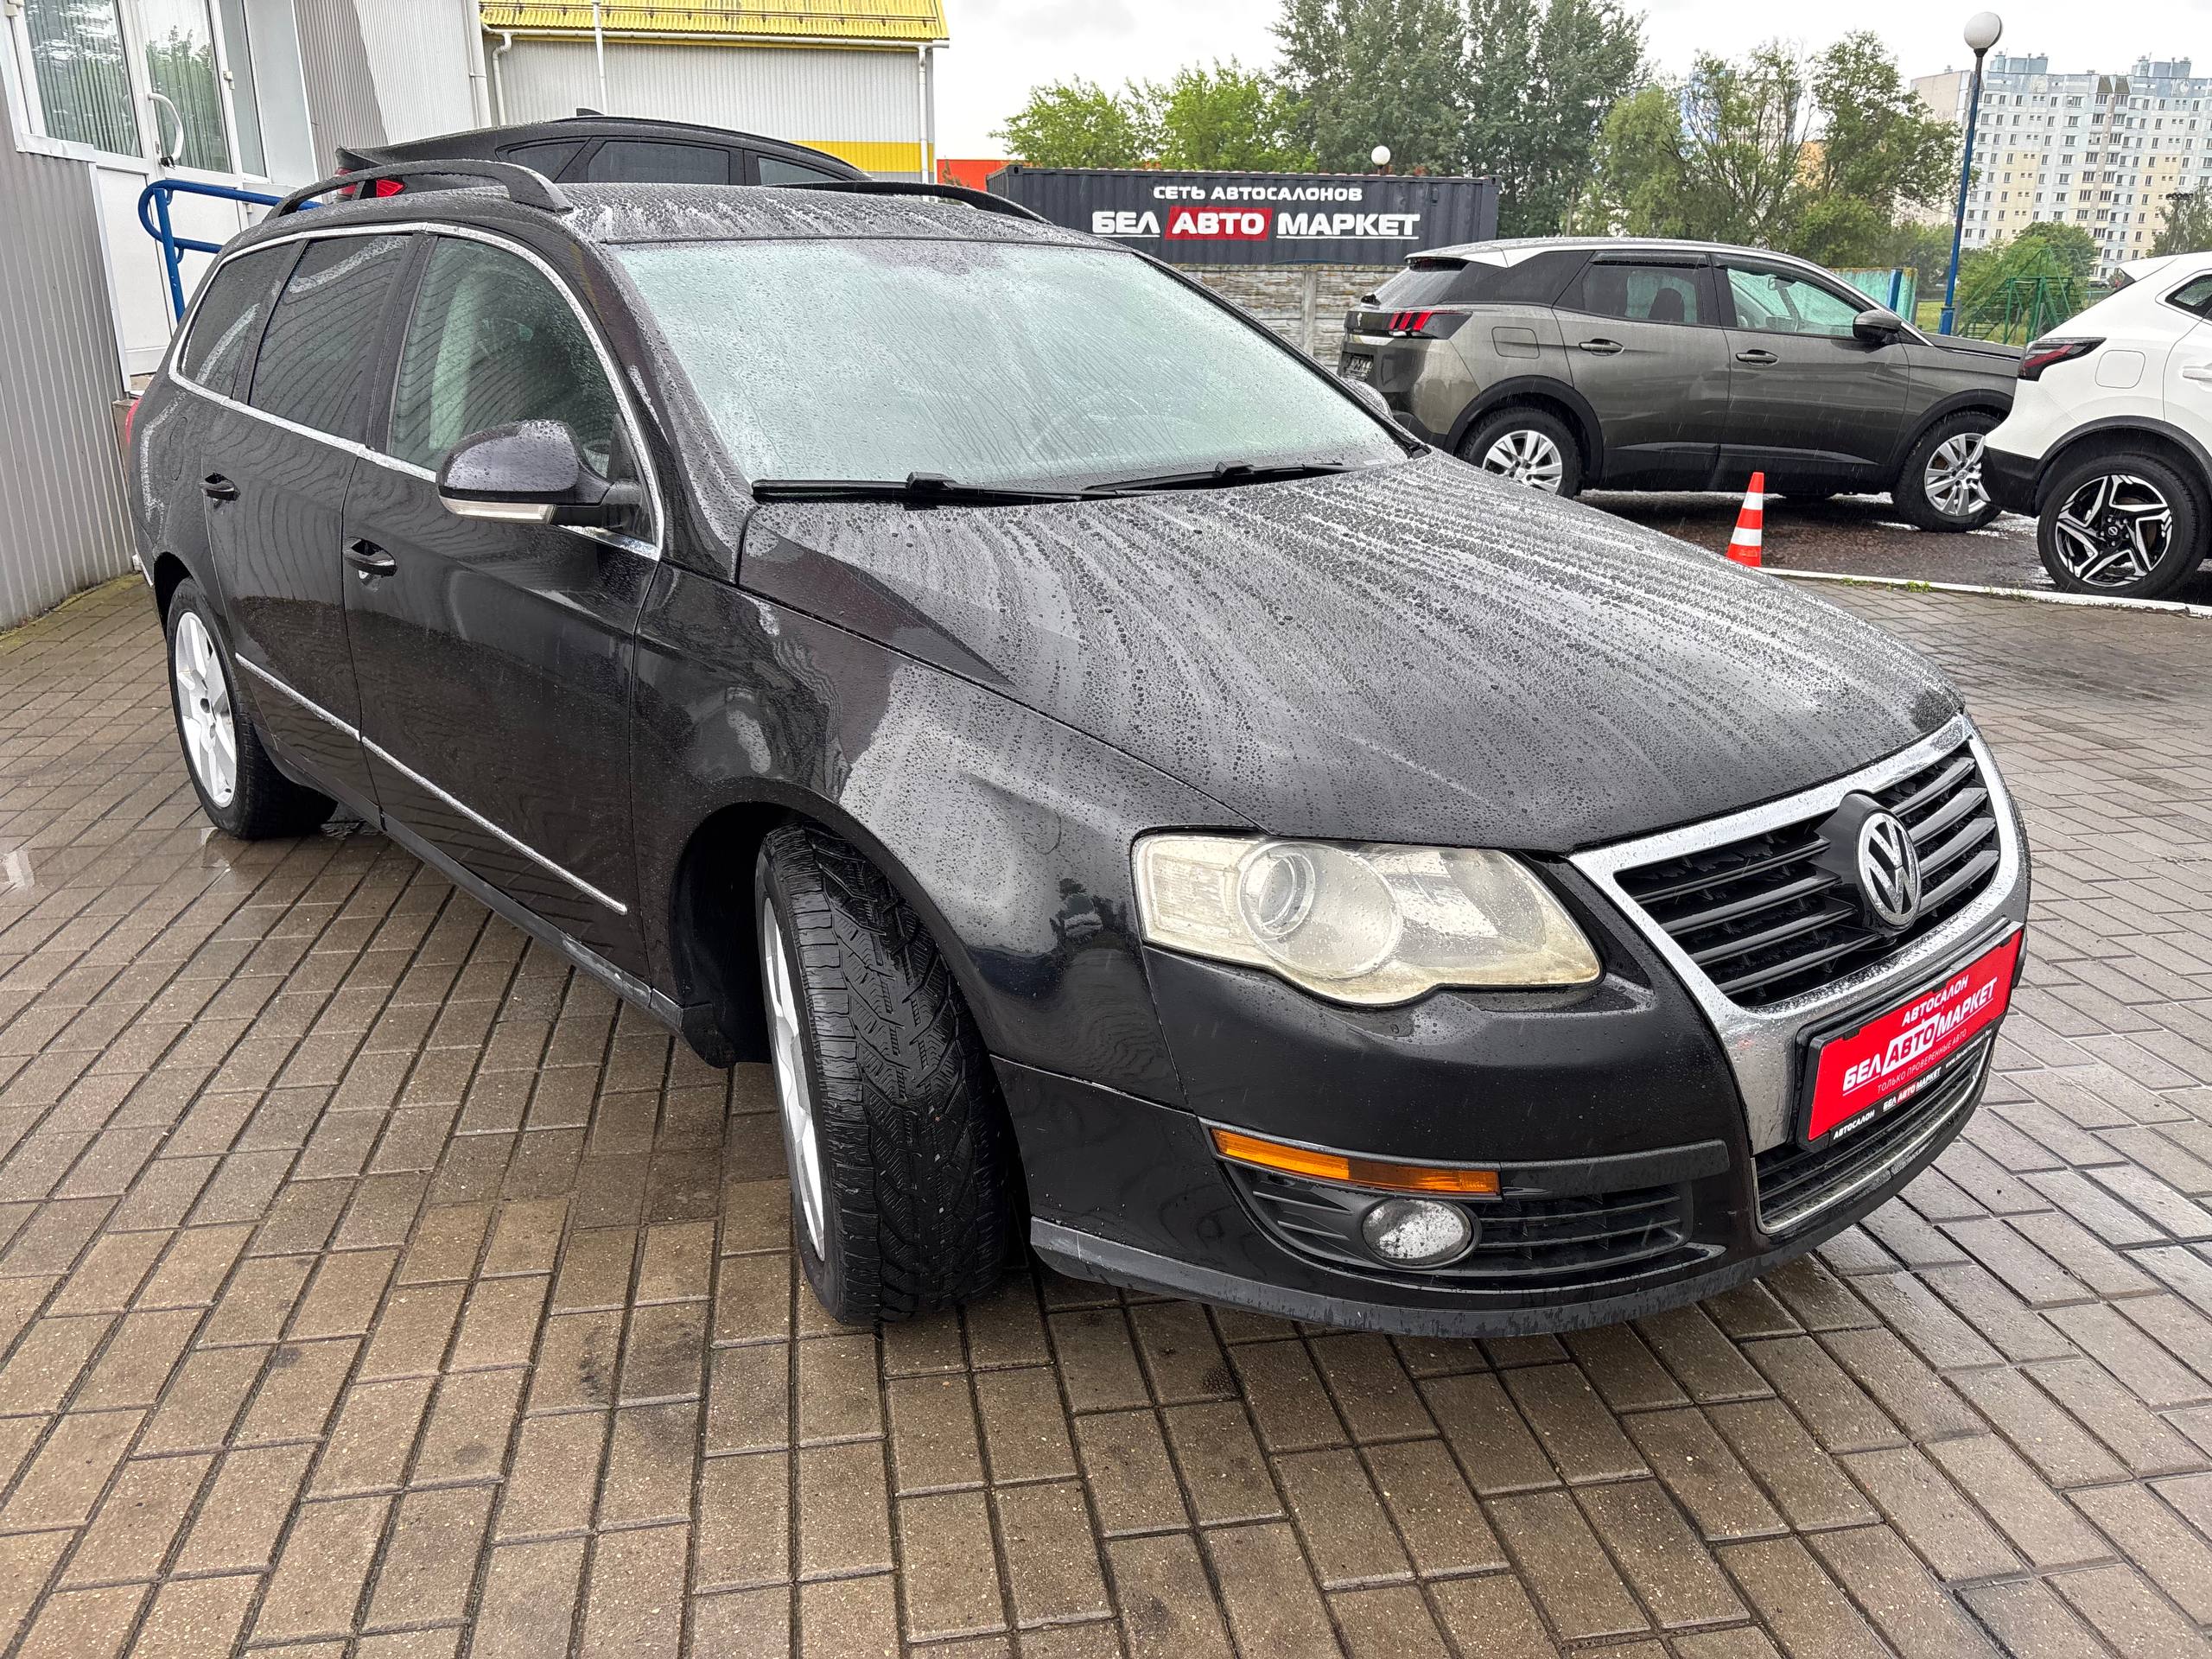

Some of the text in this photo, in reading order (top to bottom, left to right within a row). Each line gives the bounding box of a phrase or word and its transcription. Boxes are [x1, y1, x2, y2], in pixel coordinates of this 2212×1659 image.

[1153, 185, 1363, 201] СЕТЬ АВТОСАЛОНОВ
[1091, 211, 1421, 236] БЕЛ АВТО МАРКЕТ
[1902, 975, 1970, 1027] АВТОСАЛОН
[1878, 1071, 1906, 1094] ТОЛЬКО
[1833, 1109, 1875, 1140] АВТОСАЛОН
